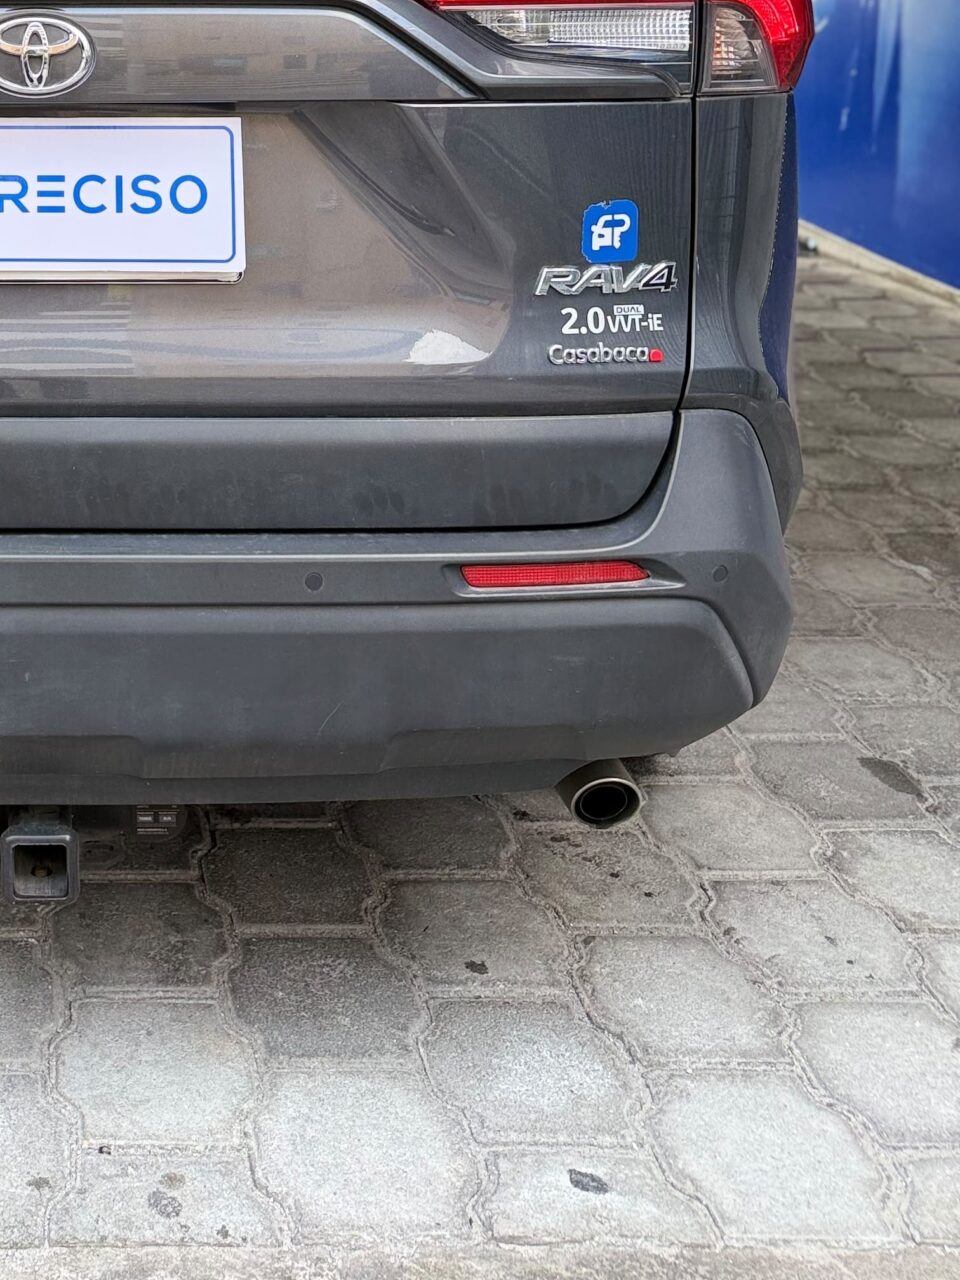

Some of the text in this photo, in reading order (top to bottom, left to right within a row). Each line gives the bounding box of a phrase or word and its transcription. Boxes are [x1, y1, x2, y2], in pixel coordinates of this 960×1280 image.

[535, 260, 678, 296] RAV4
[560, 306, 606, 335] 2.0
[615, 305, 643, 314] DUAL
[548, 341, 650, 365] Casabaca
